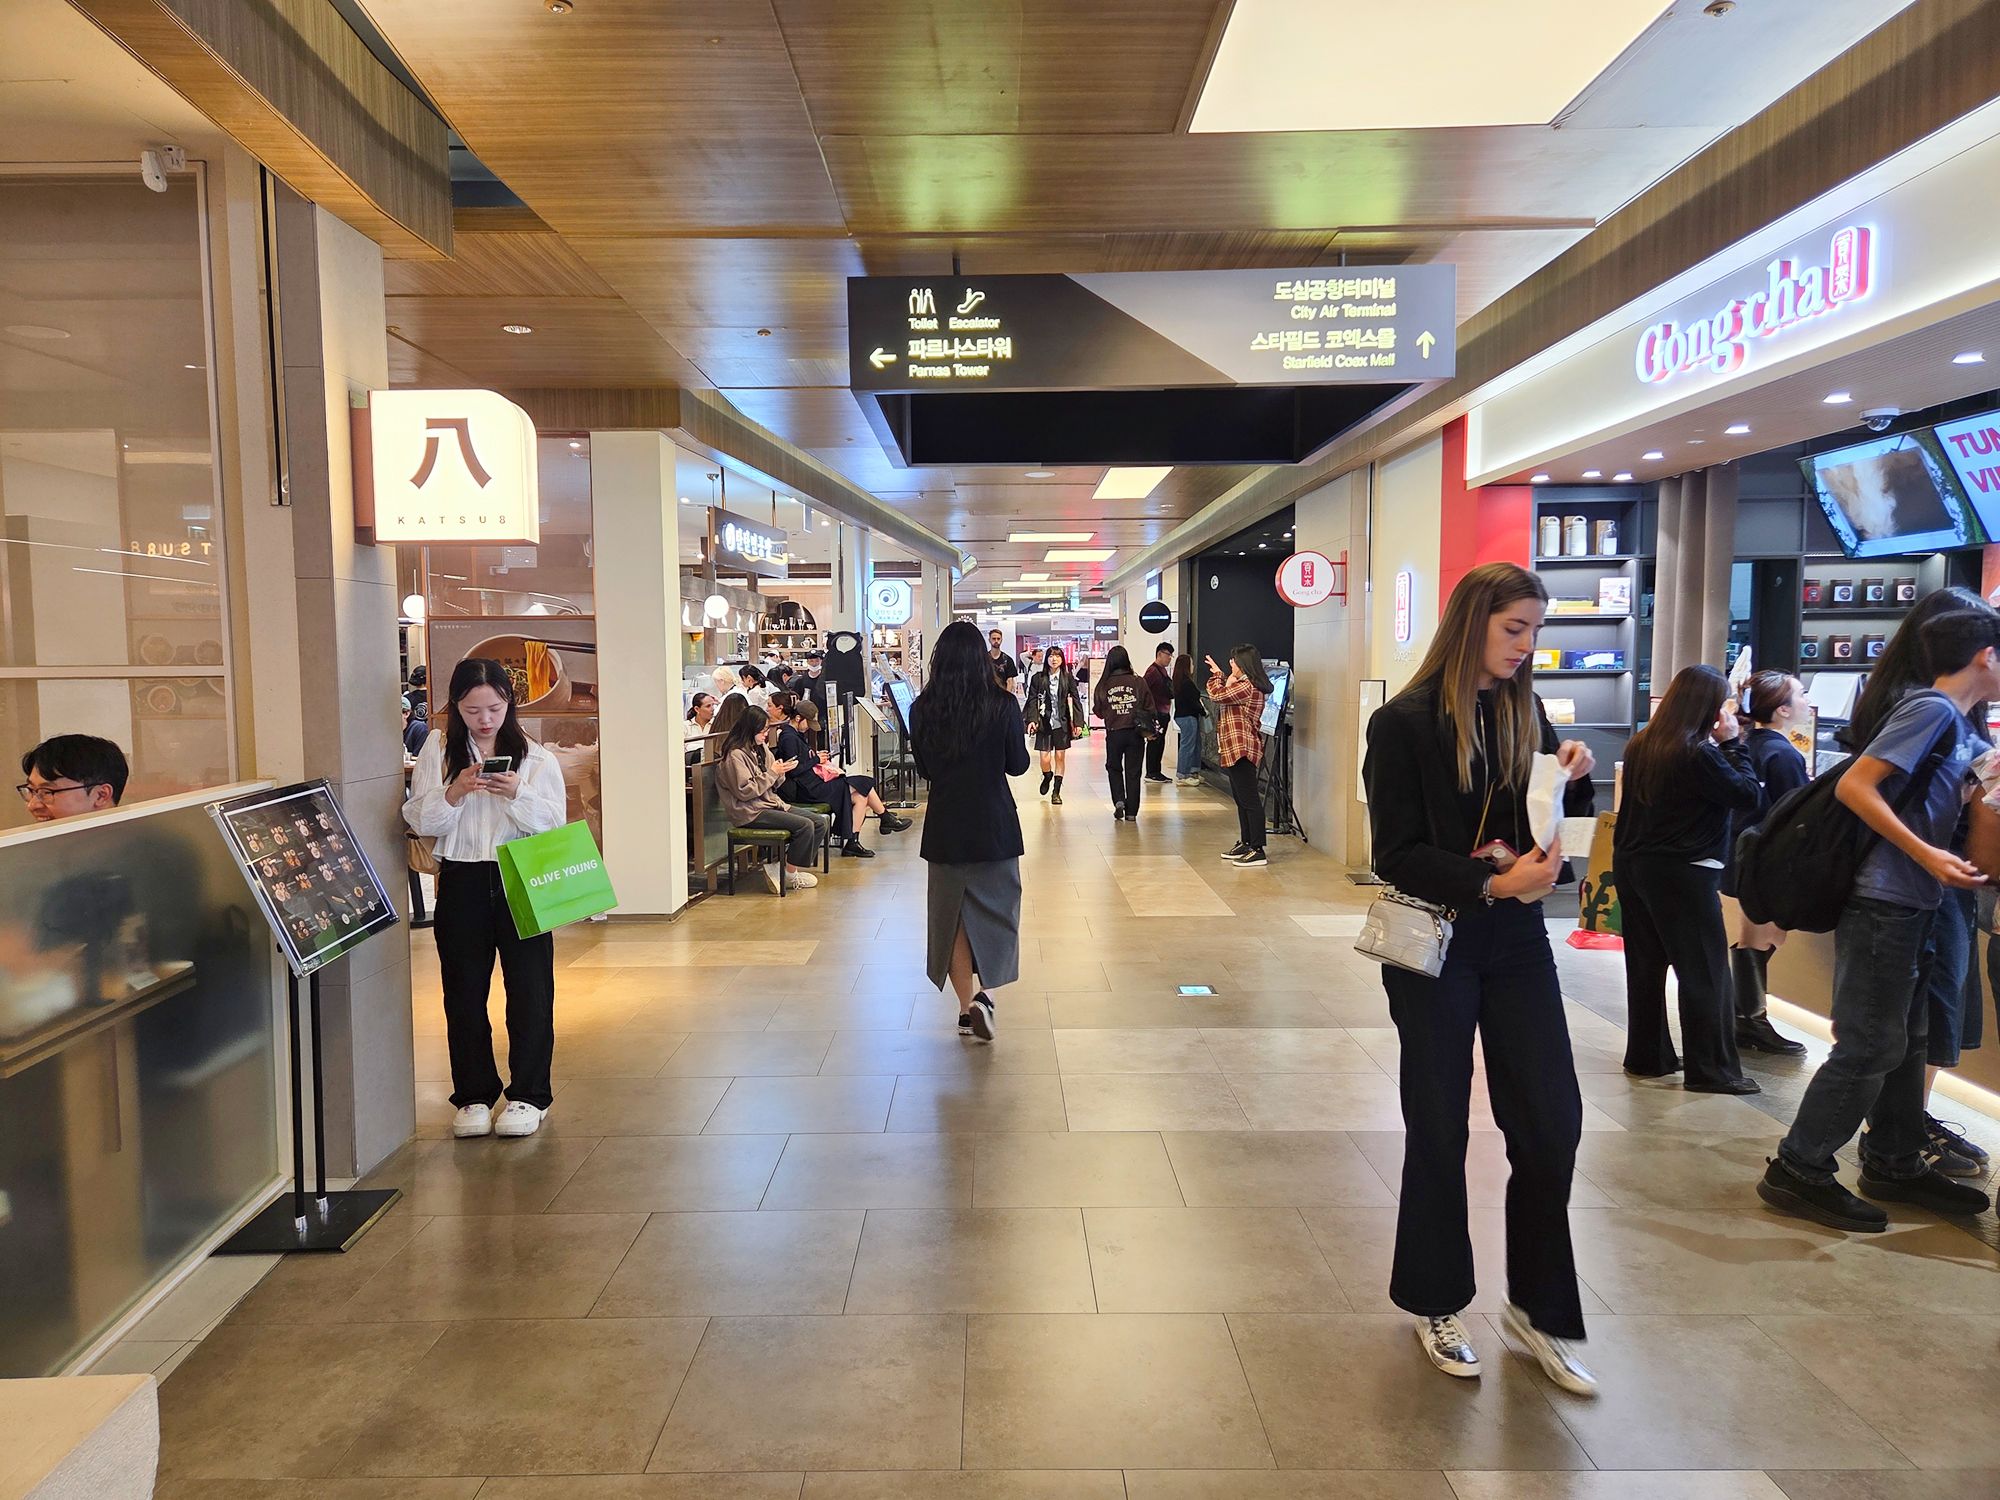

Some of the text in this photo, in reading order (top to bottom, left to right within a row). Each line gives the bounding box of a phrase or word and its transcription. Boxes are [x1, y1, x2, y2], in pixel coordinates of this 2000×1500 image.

[1273, 276, 1396, 302] 도심공항터미널
[1290, 302, 1397, 321] City Air Terminal
[908, 317, 939, 330] Toilet
[948, 317, 1001, 330] Escalator
[907, 337, 1012, 361] 파르나스타워
[1249, 327, 1397, 352] 스타필드 코엑스몰
[908, 363, 990, 378] Parnas Tower
[1282, 352, 1396, 370] Starfield Coex Mall
[529, 858, 599, 888] OLIVE YOUNG
